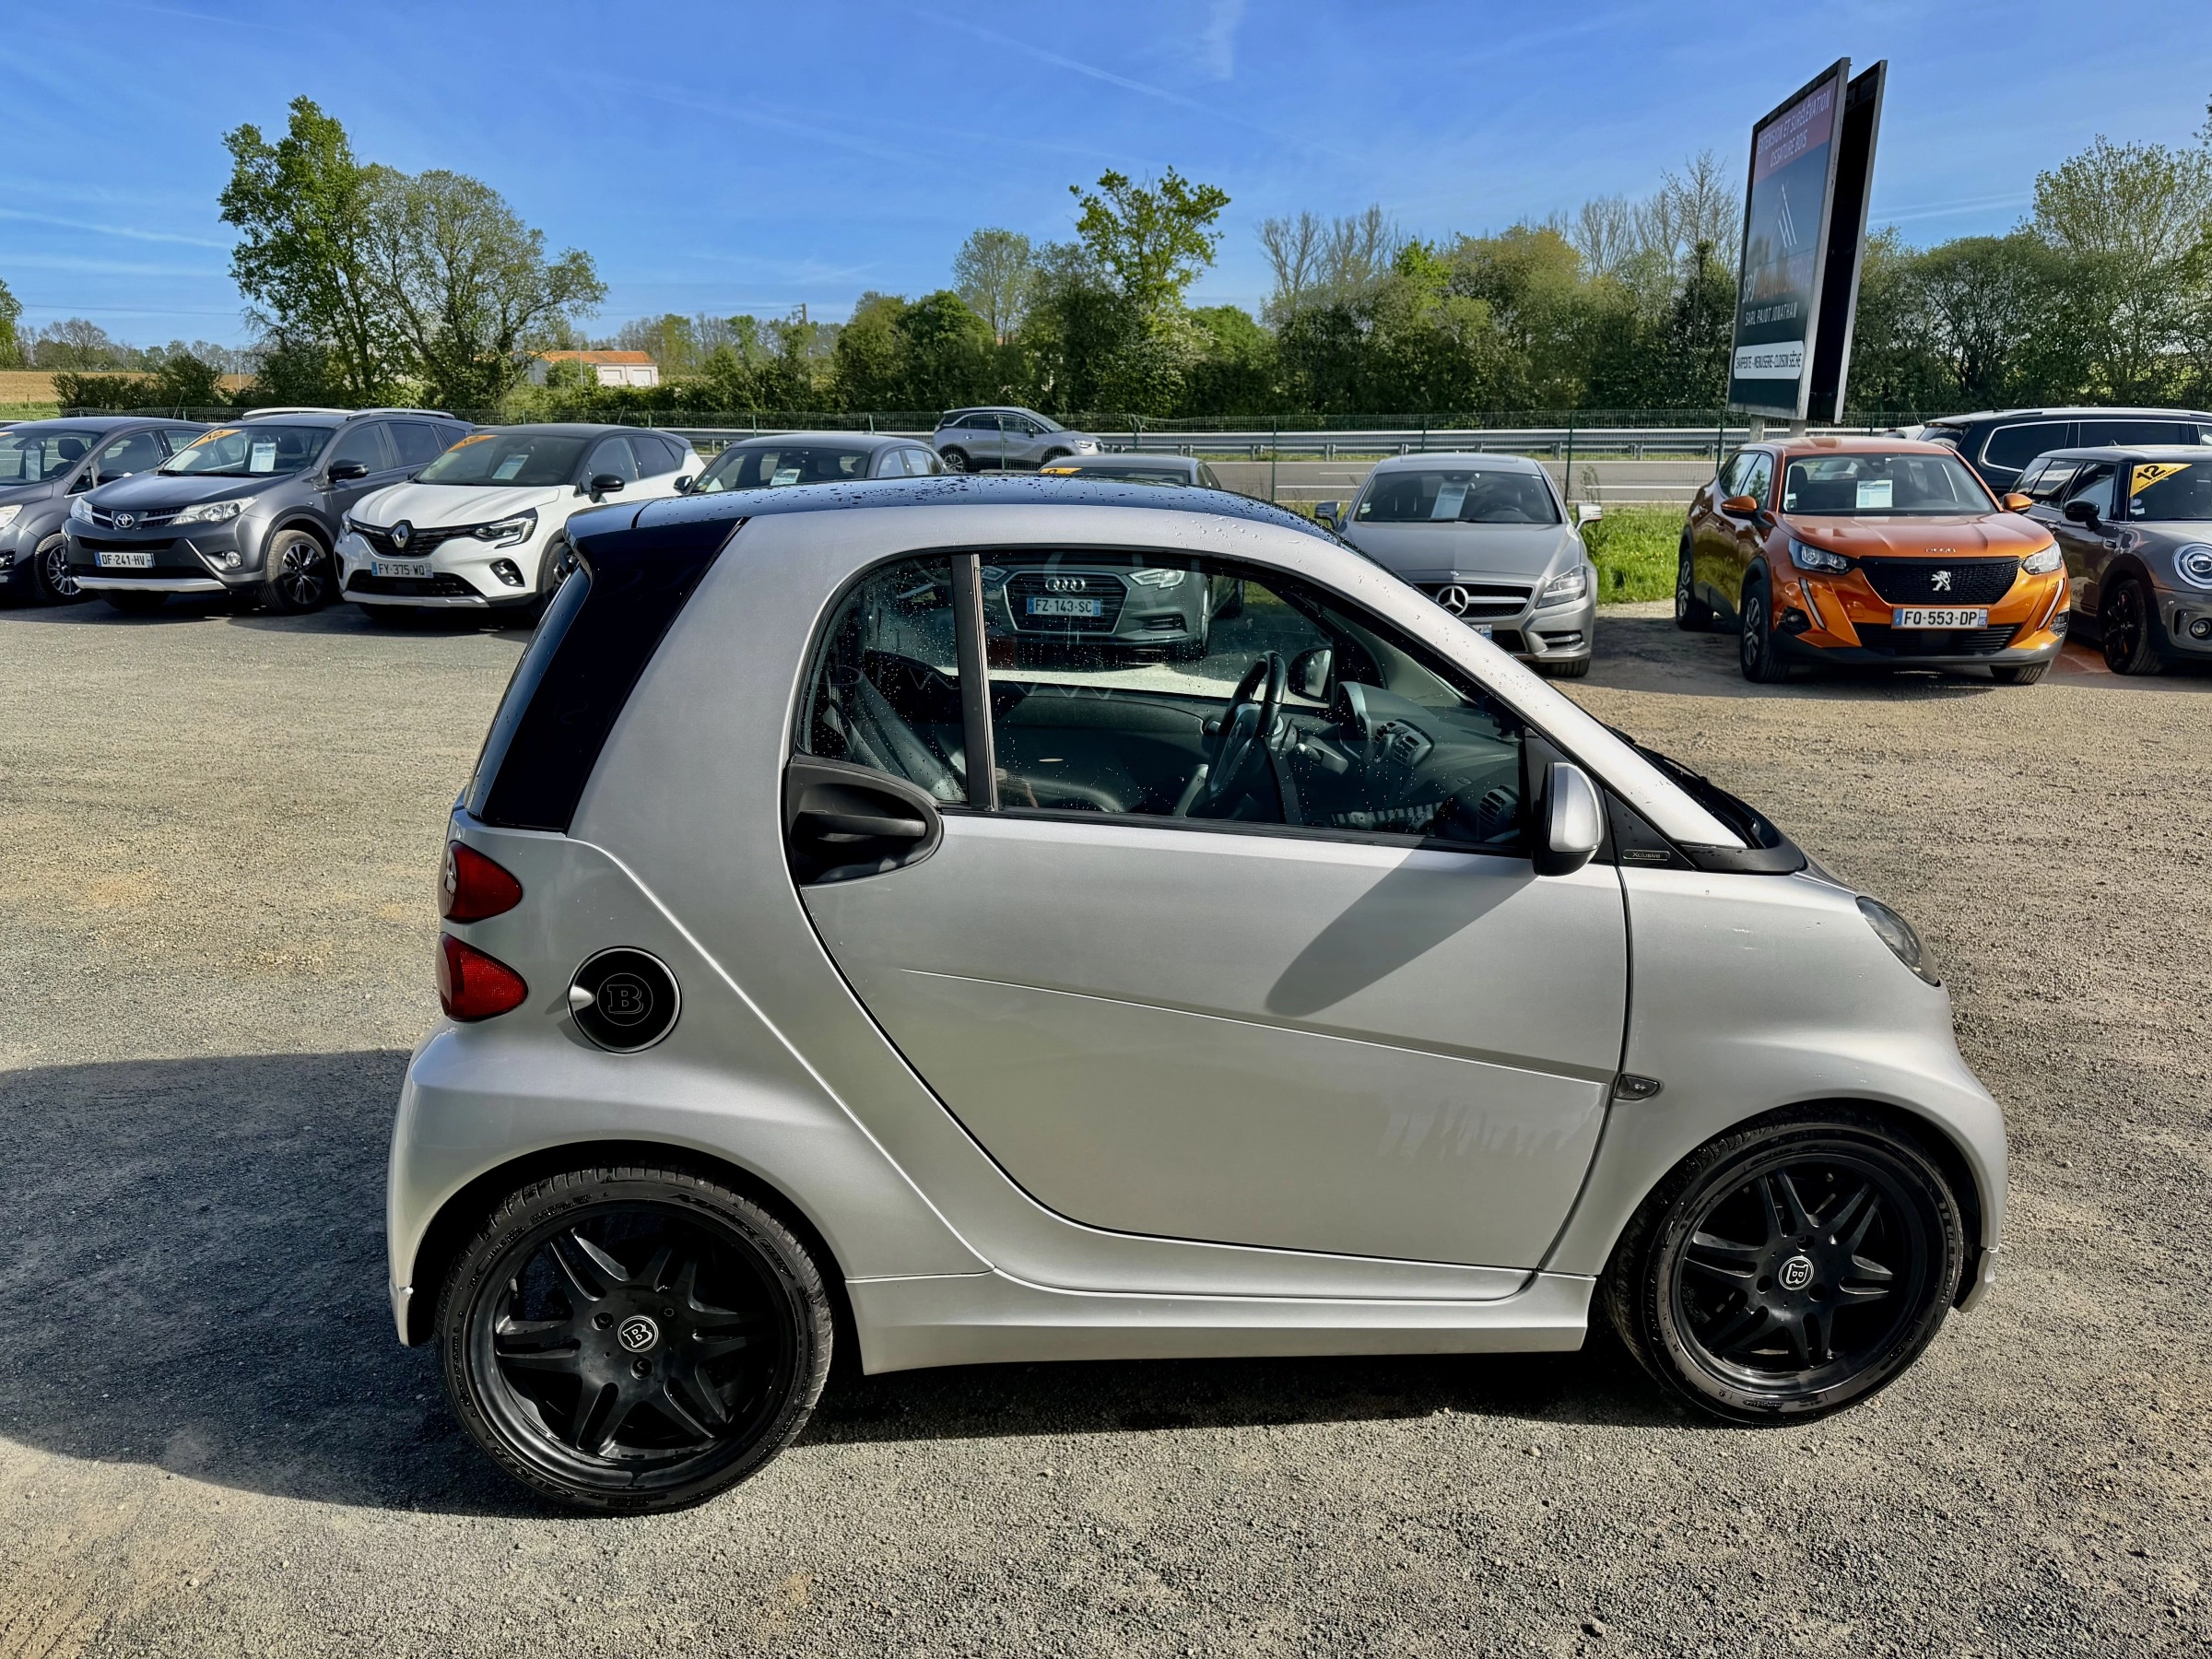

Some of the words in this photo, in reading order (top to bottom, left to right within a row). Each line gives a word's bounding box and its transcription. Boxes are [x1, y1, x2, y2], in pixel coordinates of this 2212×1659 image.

[1758, 124, 1783, 155] EXTENSION
[1770, 136, 1796, 168] OSSATURE
[1794, 129, 1808, 154] BOIS
[1742, 266, 1759, 304] SPJ
[1745, 310, 1757, 326] SARL
[1757, 307, 1771, 324] PAJOT
[1771, 301, 1798, 323] JONATHAN
[2136, 465, 2166, 480] 12
[101, 554, 145, 566] DF-241-HV
[378, 563, 425, 576] FY-375-WQ
[1035, 599, 1092, 613] FZ-143-SC
[1903, 611, 1977, 625] FQ-553-DP
[606, 983, 644, 1015] B
[1785, 1263, 1809, 1285] B
[622, 1323, 653, 1348] B
